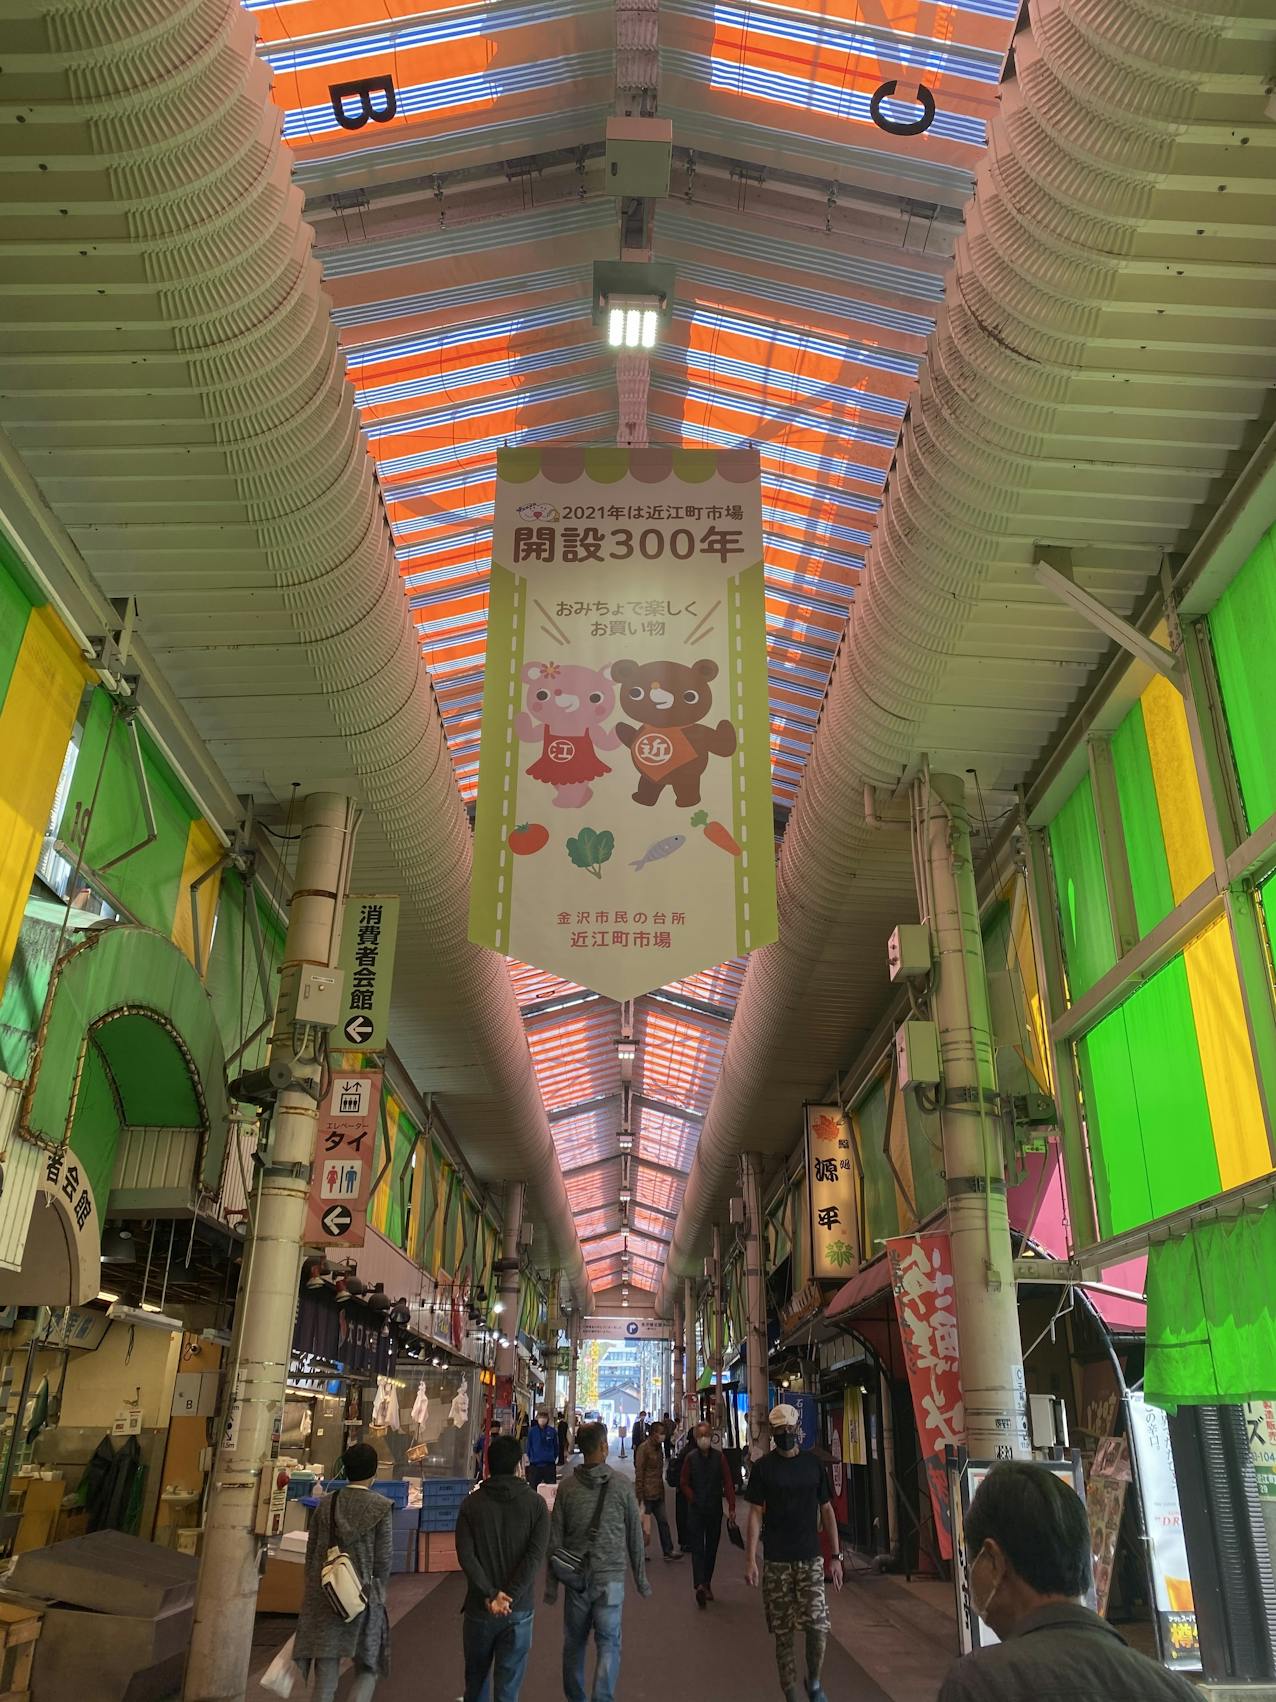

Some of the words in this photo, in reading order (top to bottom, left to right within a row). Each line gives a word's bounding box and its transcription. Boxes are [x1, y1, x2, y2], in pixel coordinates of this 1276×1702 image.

[328, 74, 397, 131] B
[870, 79, 936, 136] C
[562, 504, 744, 521] 2021年は近江町市場
[513, 526, 745, 564] 開設300年
[556, 600, 699, 618] おみちょで楽しく
[590, 619, 666, 637] お買い物
[550, 743, 572, 759] 江
[638, 739, 670, 762] 近
[557, 911, 686, 926] 金沢市民の台所
[570, 930, 672, 949] 近江町市場
[349, 904, 383, 1011] 消費者会館
[326, 1120, 369, 1130] エレベーター
[325, 1131, 368, 1152] タイ
[814, 1157, 841, 1231] 源平
